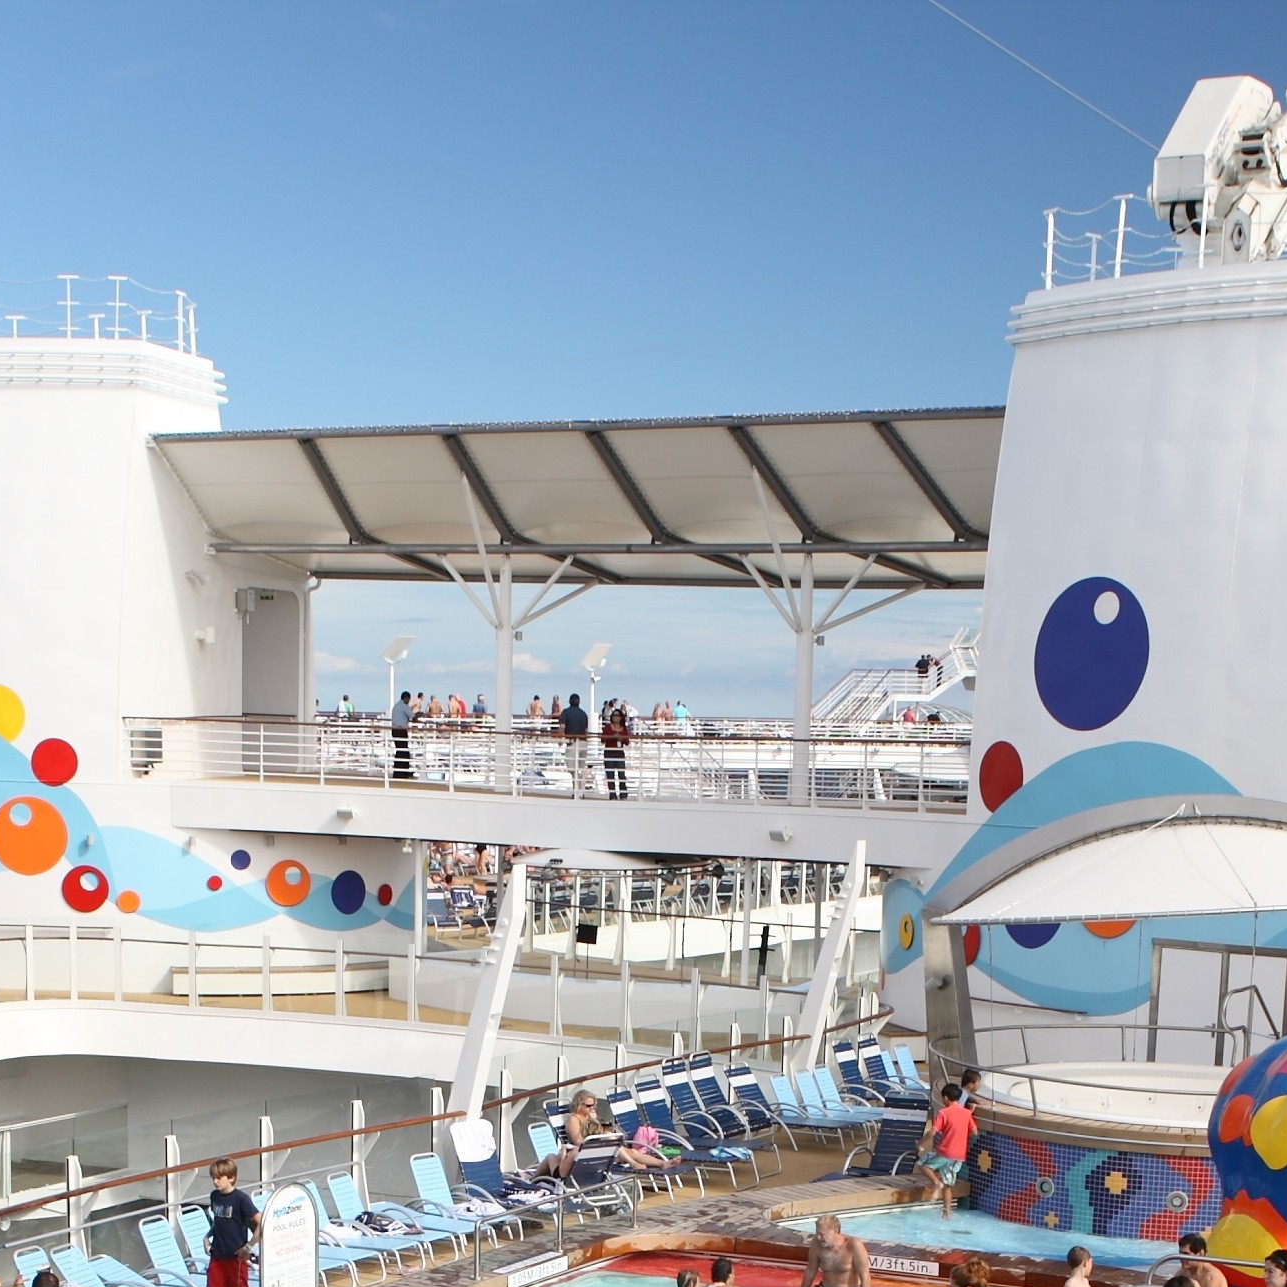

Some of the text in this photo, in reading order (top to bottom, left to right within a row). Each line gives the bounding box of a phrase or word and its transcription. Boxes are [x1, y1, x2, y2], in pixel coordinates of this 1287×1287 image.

[272, 1218, 306, 1233] POOL RULES
[869, 1256, 932, 1274] M/3ft.5in.
